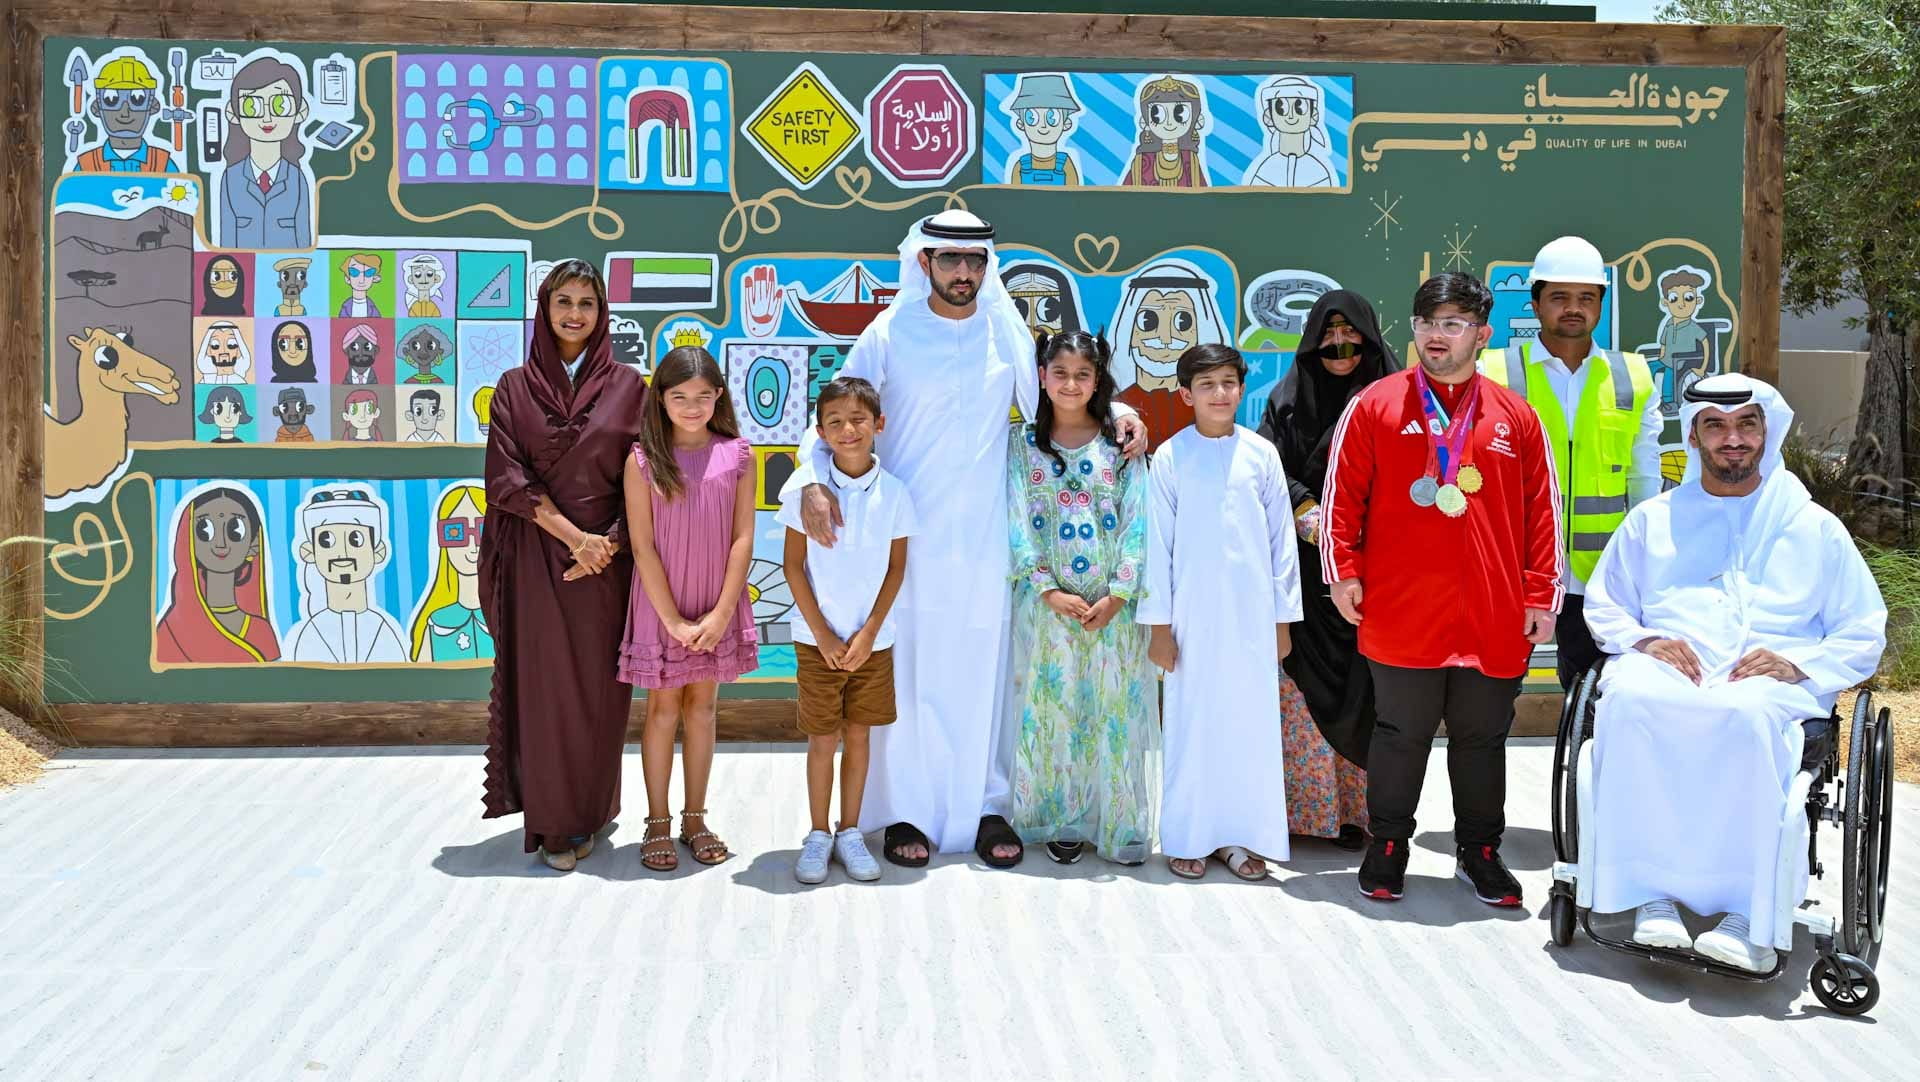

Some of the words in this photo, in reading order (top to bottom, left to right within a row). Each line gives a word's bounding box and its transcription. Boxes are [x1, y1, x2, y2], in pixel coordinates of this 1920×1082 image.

[891, 99, 953, 124] السلامة
[1523, 72, 1649, 123] الحياة
[1646, 84, 1730, 125] جودة
[771, 109, 836, 127] SAFETY
[783, 129, 830, 146] FIRST
[1360, 129, 1489, 173] دبي
[1497, 115, 1537, 173] في
[1545, 138, 1589, 149] QUALITY
[1594, 138, 1607, 149] OF
[1611, 138, 1631, 149] LIFE
[1638, 138, 1648, 149] IN
[1655, 138, 1687, 149] DUBAI
